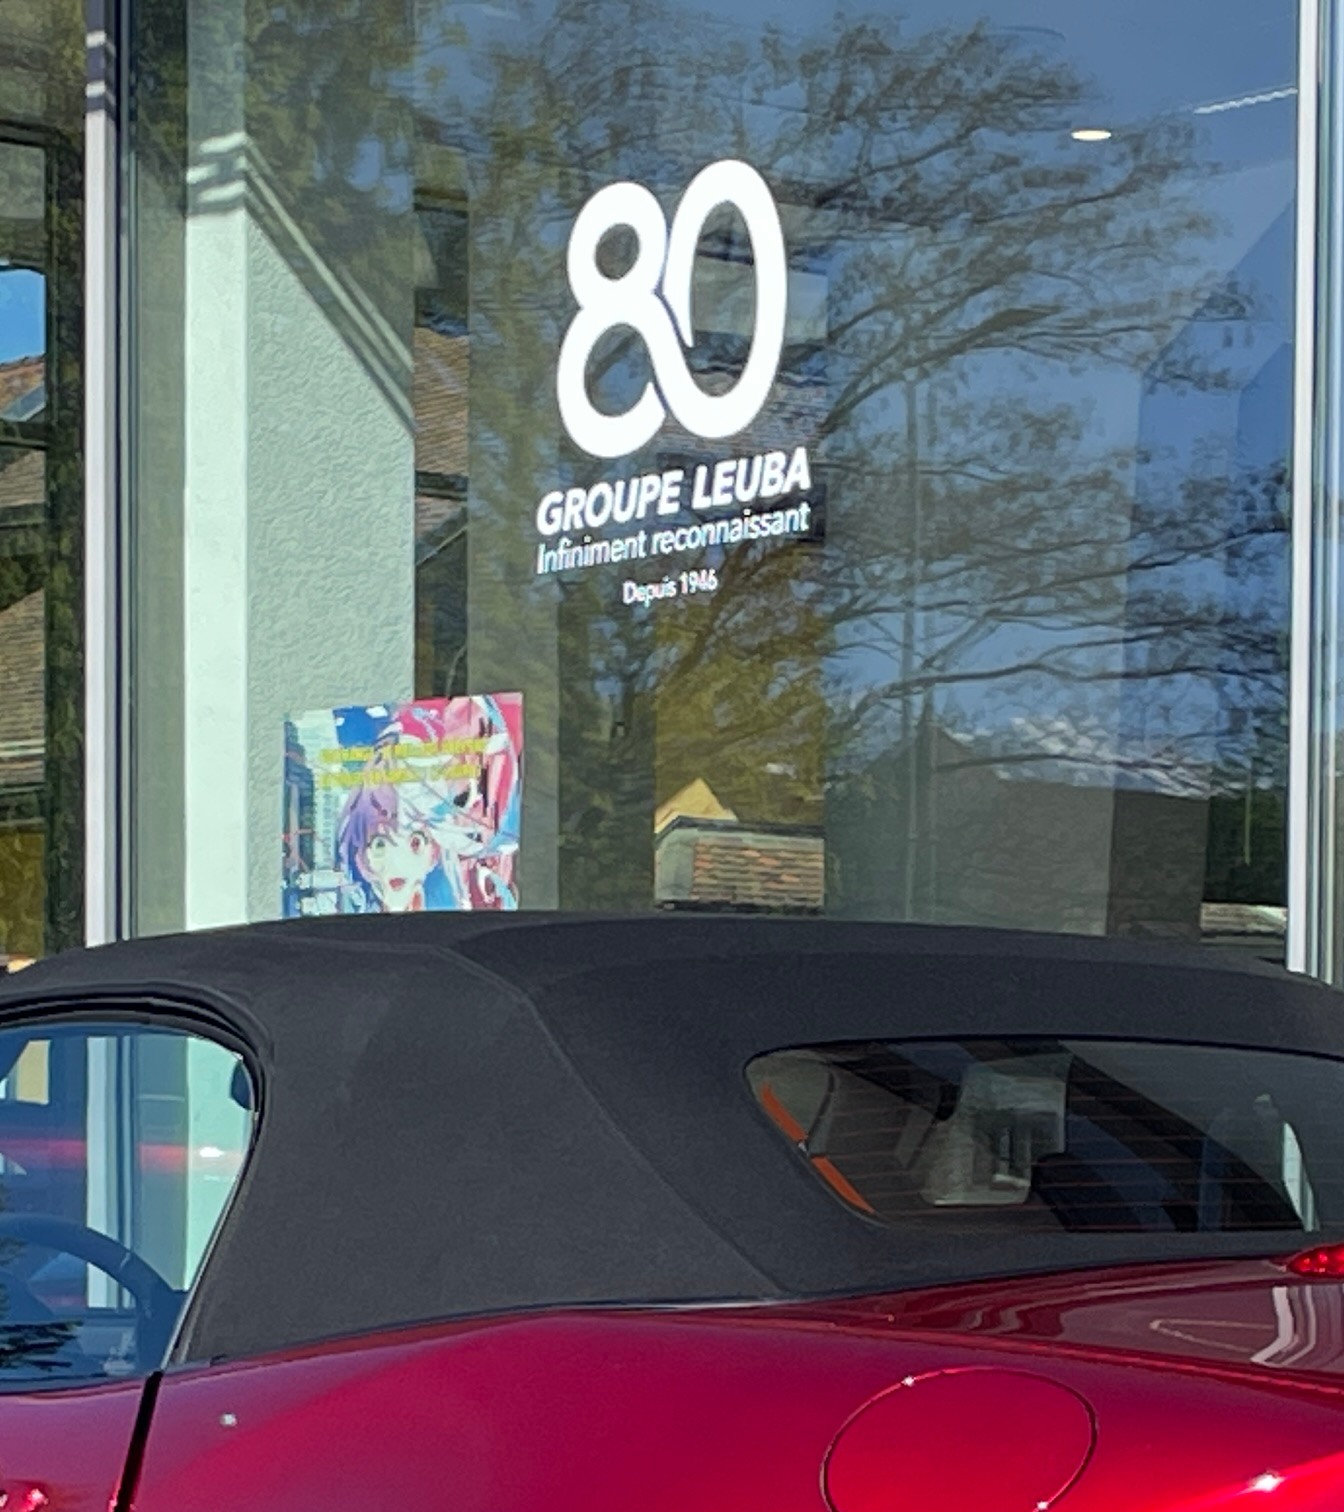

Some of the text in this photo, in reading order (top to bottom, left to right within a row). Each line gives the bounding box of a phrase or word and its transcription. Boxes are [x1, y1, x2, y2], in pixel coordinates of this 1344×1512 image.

[558, 160, 788, 458] 80
[536, 446, 812, 537] GROUPE LEUBA
[536, 502, 812, 575] Infiniment reconnaissant
[622, 575, 677, 607] Depuis
